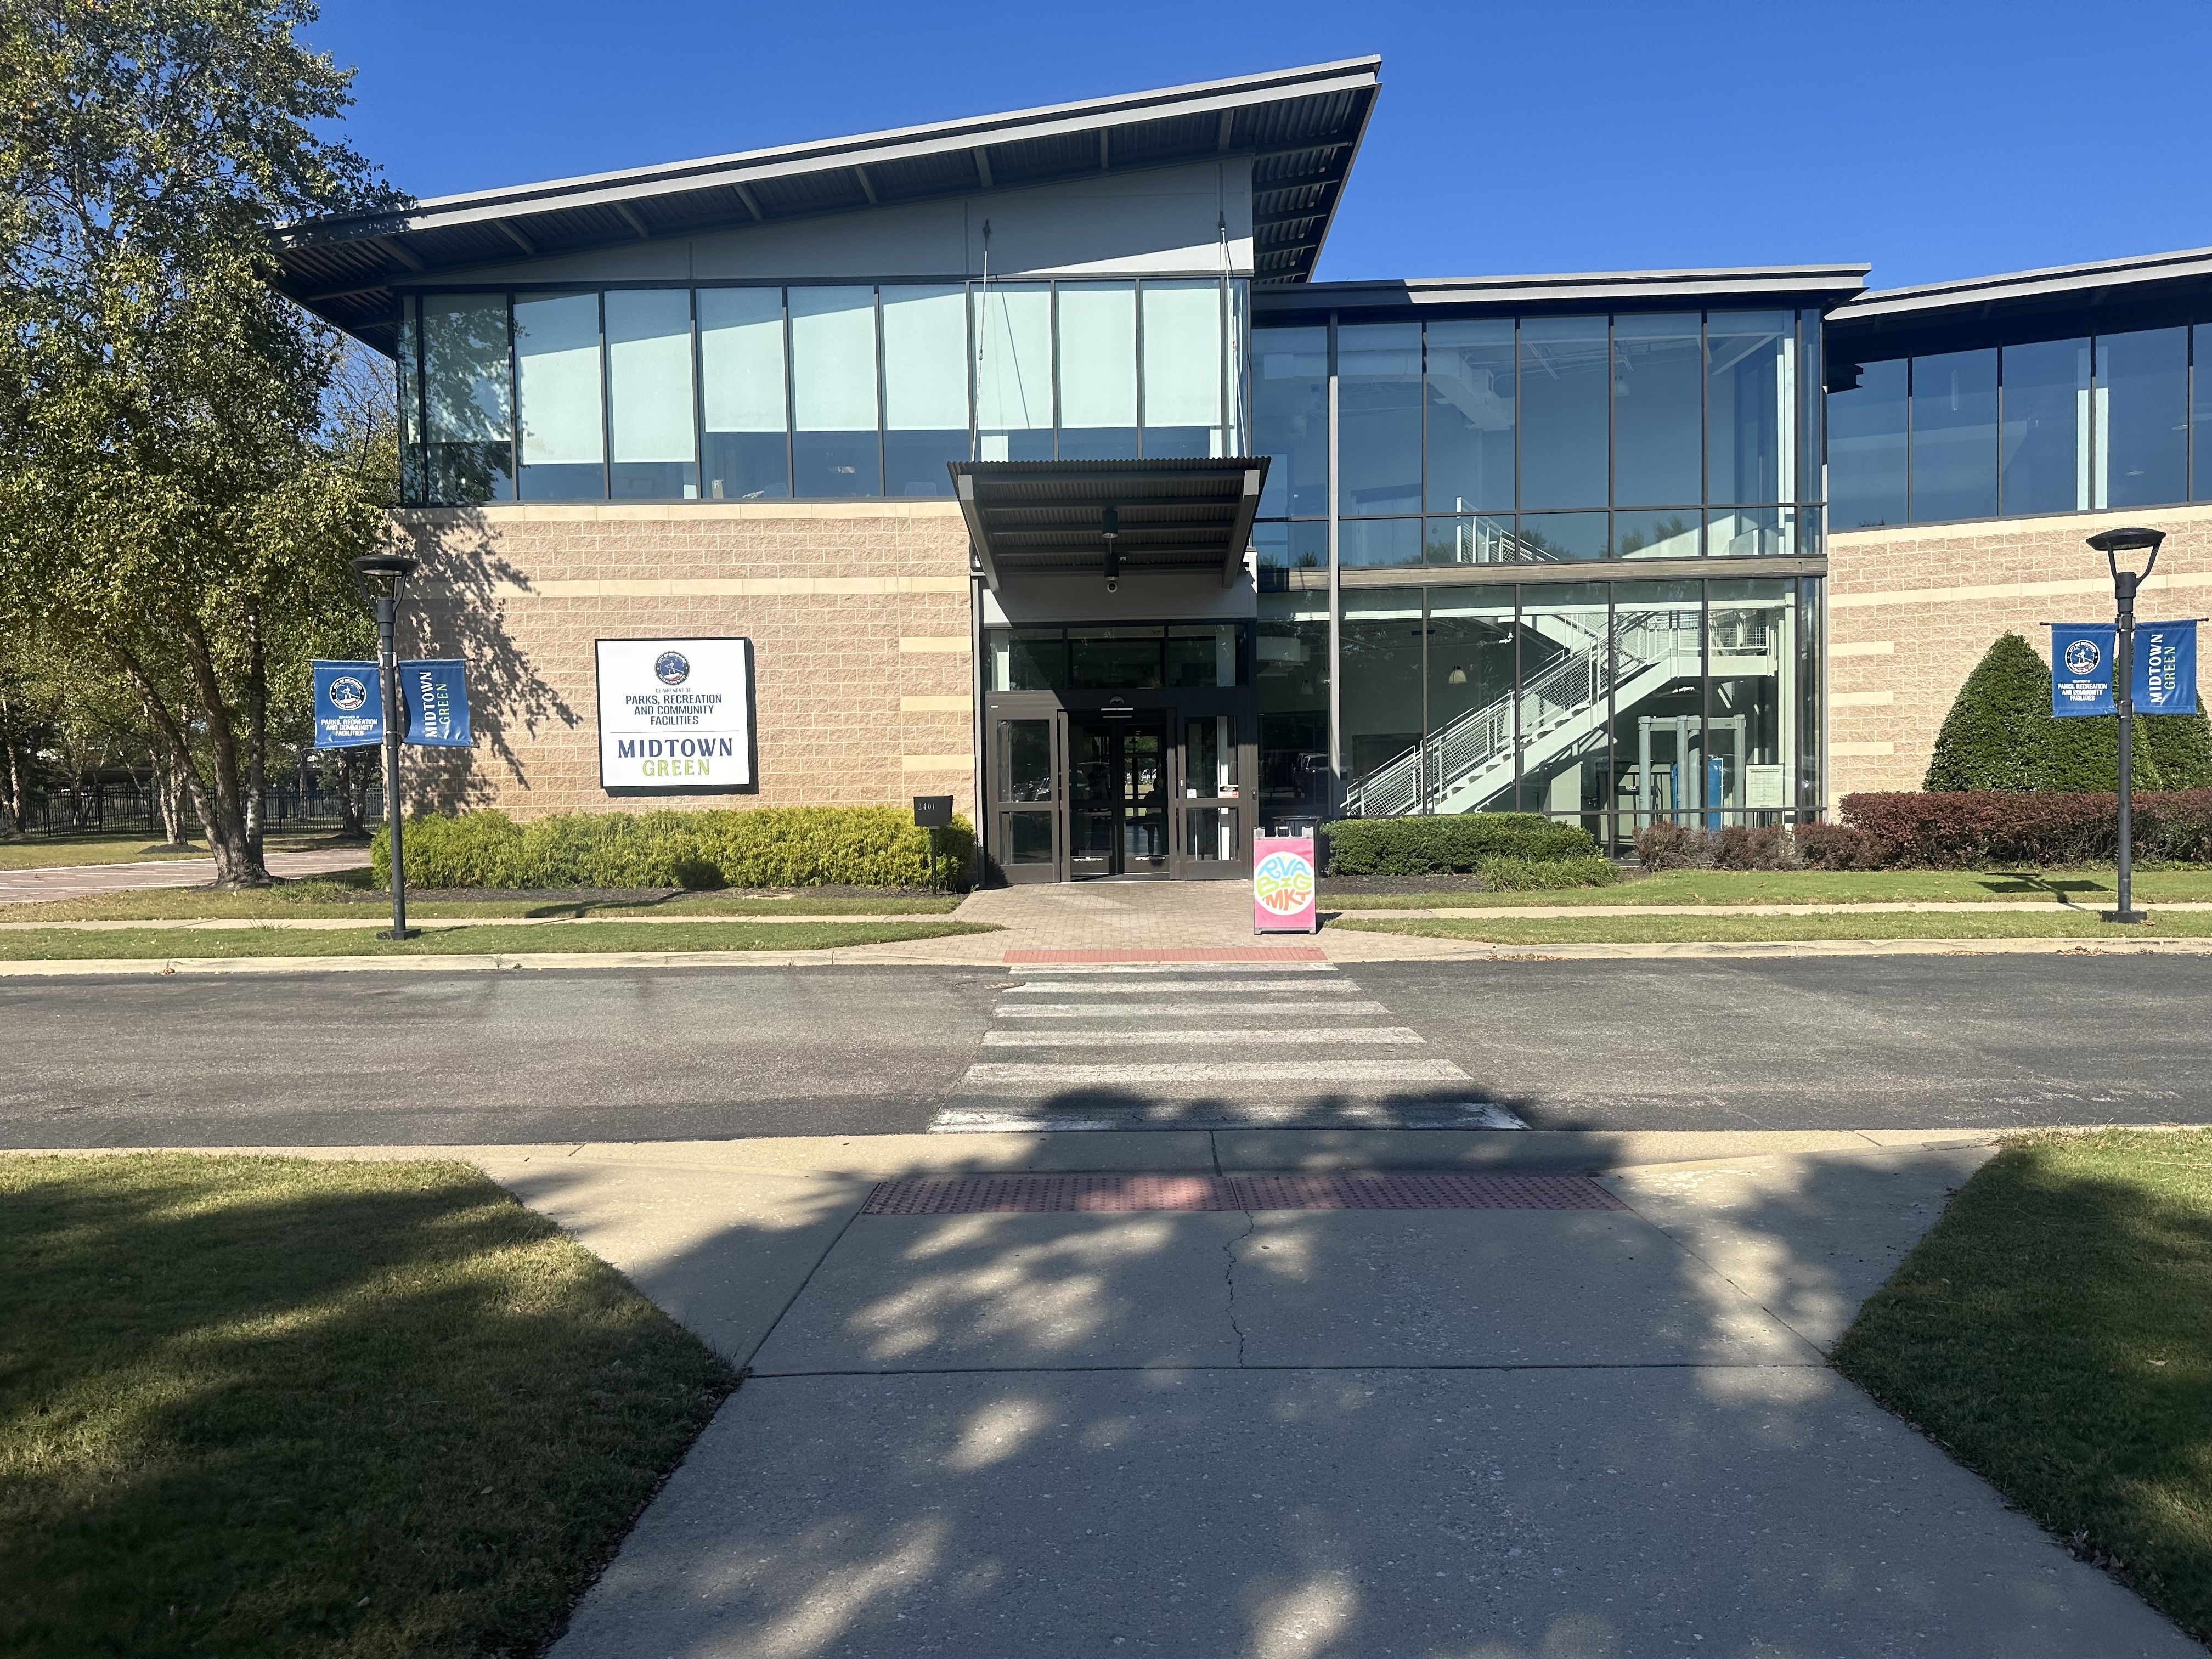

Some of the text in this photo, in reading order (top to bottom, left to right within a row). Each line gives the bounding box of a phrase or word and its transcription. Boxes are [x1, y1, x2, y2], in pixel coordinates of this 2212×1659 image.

[2148, 634, 2163, 703] MIDTOWN
[2164, 646, 2176, 690] GREEN
[419, 671, 437, 738] MIDTOWN
[435, 683, 450, 725] GREEN
[625, 694, 722, 706] PARKS, RECREATION
[634, 704, 714, 715] AND COMMUNITY
[650, 715, 699, 725] FACILITIES
[617, 738, 732, 758] MIDTOWN
[642, 759, 710, 776] GREEN
[1257, 856, 1311, 879] RVA
[1256, 873, 1313, 896] BIG
[1262, 888, 1312, 911] MKT
